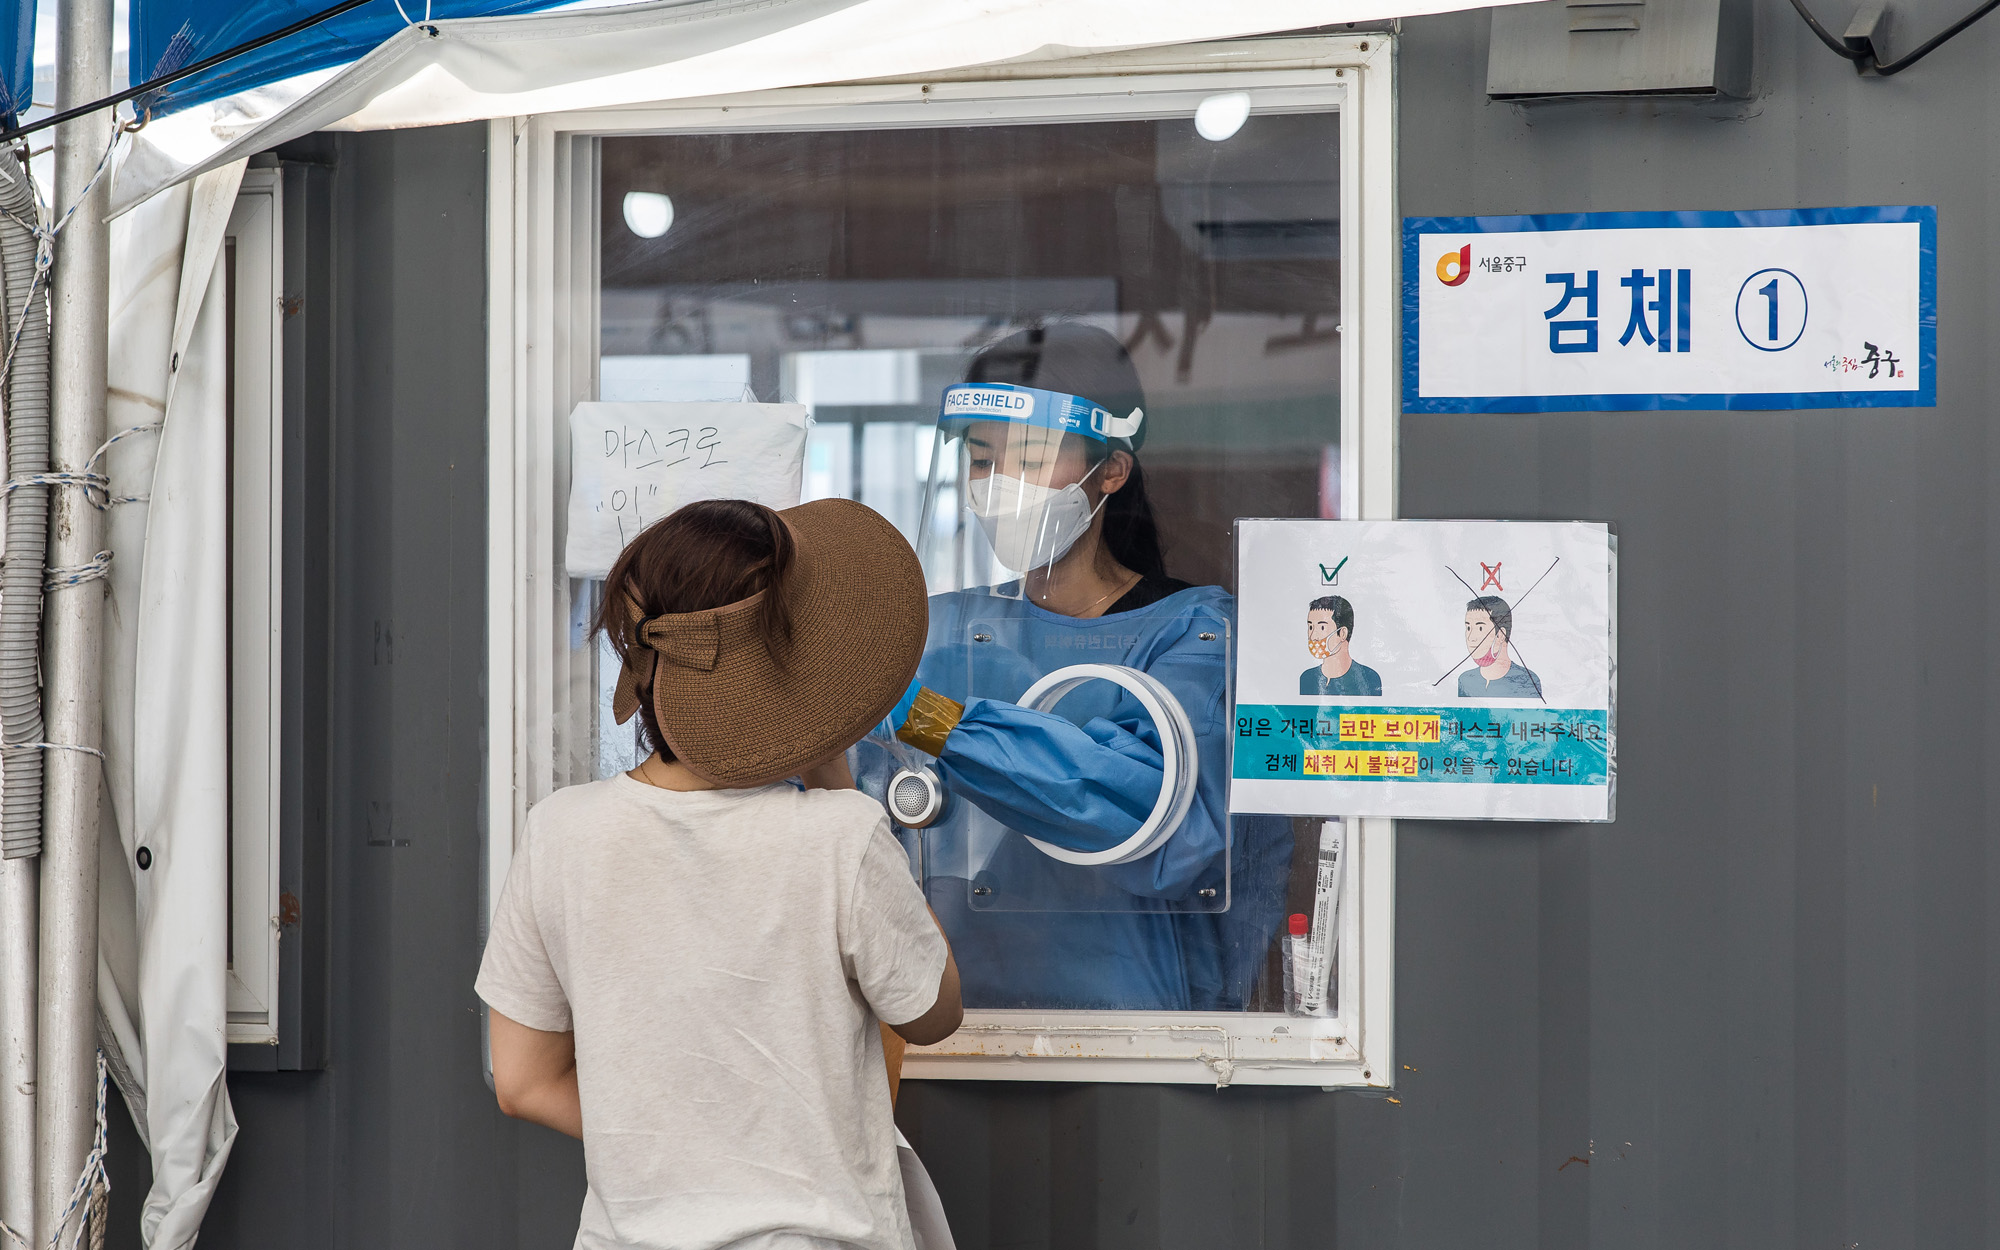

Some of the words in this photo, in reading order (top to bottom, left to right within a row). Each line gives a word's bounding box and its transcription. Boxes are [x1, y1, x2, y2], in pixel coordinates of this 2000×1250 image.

[1478, 256, 1527, 273] 서울중구
[1544, 269, 1691, 354] 검체
[1841, 356, 1858, 373] 중심
[1861, 341, 1900, 379] 중구
[946, 393, 970, 408] FACE
[972, 393, 1025, 410] SHIELD
[605, 425, 728, 470] 마스크로
[1237, 717, 1272, 737] 입은
[1280, 718, 1333, 739] 가리고
[1340, 719, 1377, 739] 코만
[1384, 720, 1439, 740] 보이게
[1448, 721, 1503, 741] 마스크
[1511, 721, 1607, 742] 내려주세요.
[1265, 754, 1297, 772] 검체
[1304, 755, 1336, 773] 채취
[1344, 755, 1359, 774] 시
[1366, 755, 1434, 775] 불편감이
[1443, 757, 1476, 775] 있을
[1483, 758, 1500, 776] 수
[1507, 758, 1578, 777] 있습니다.
